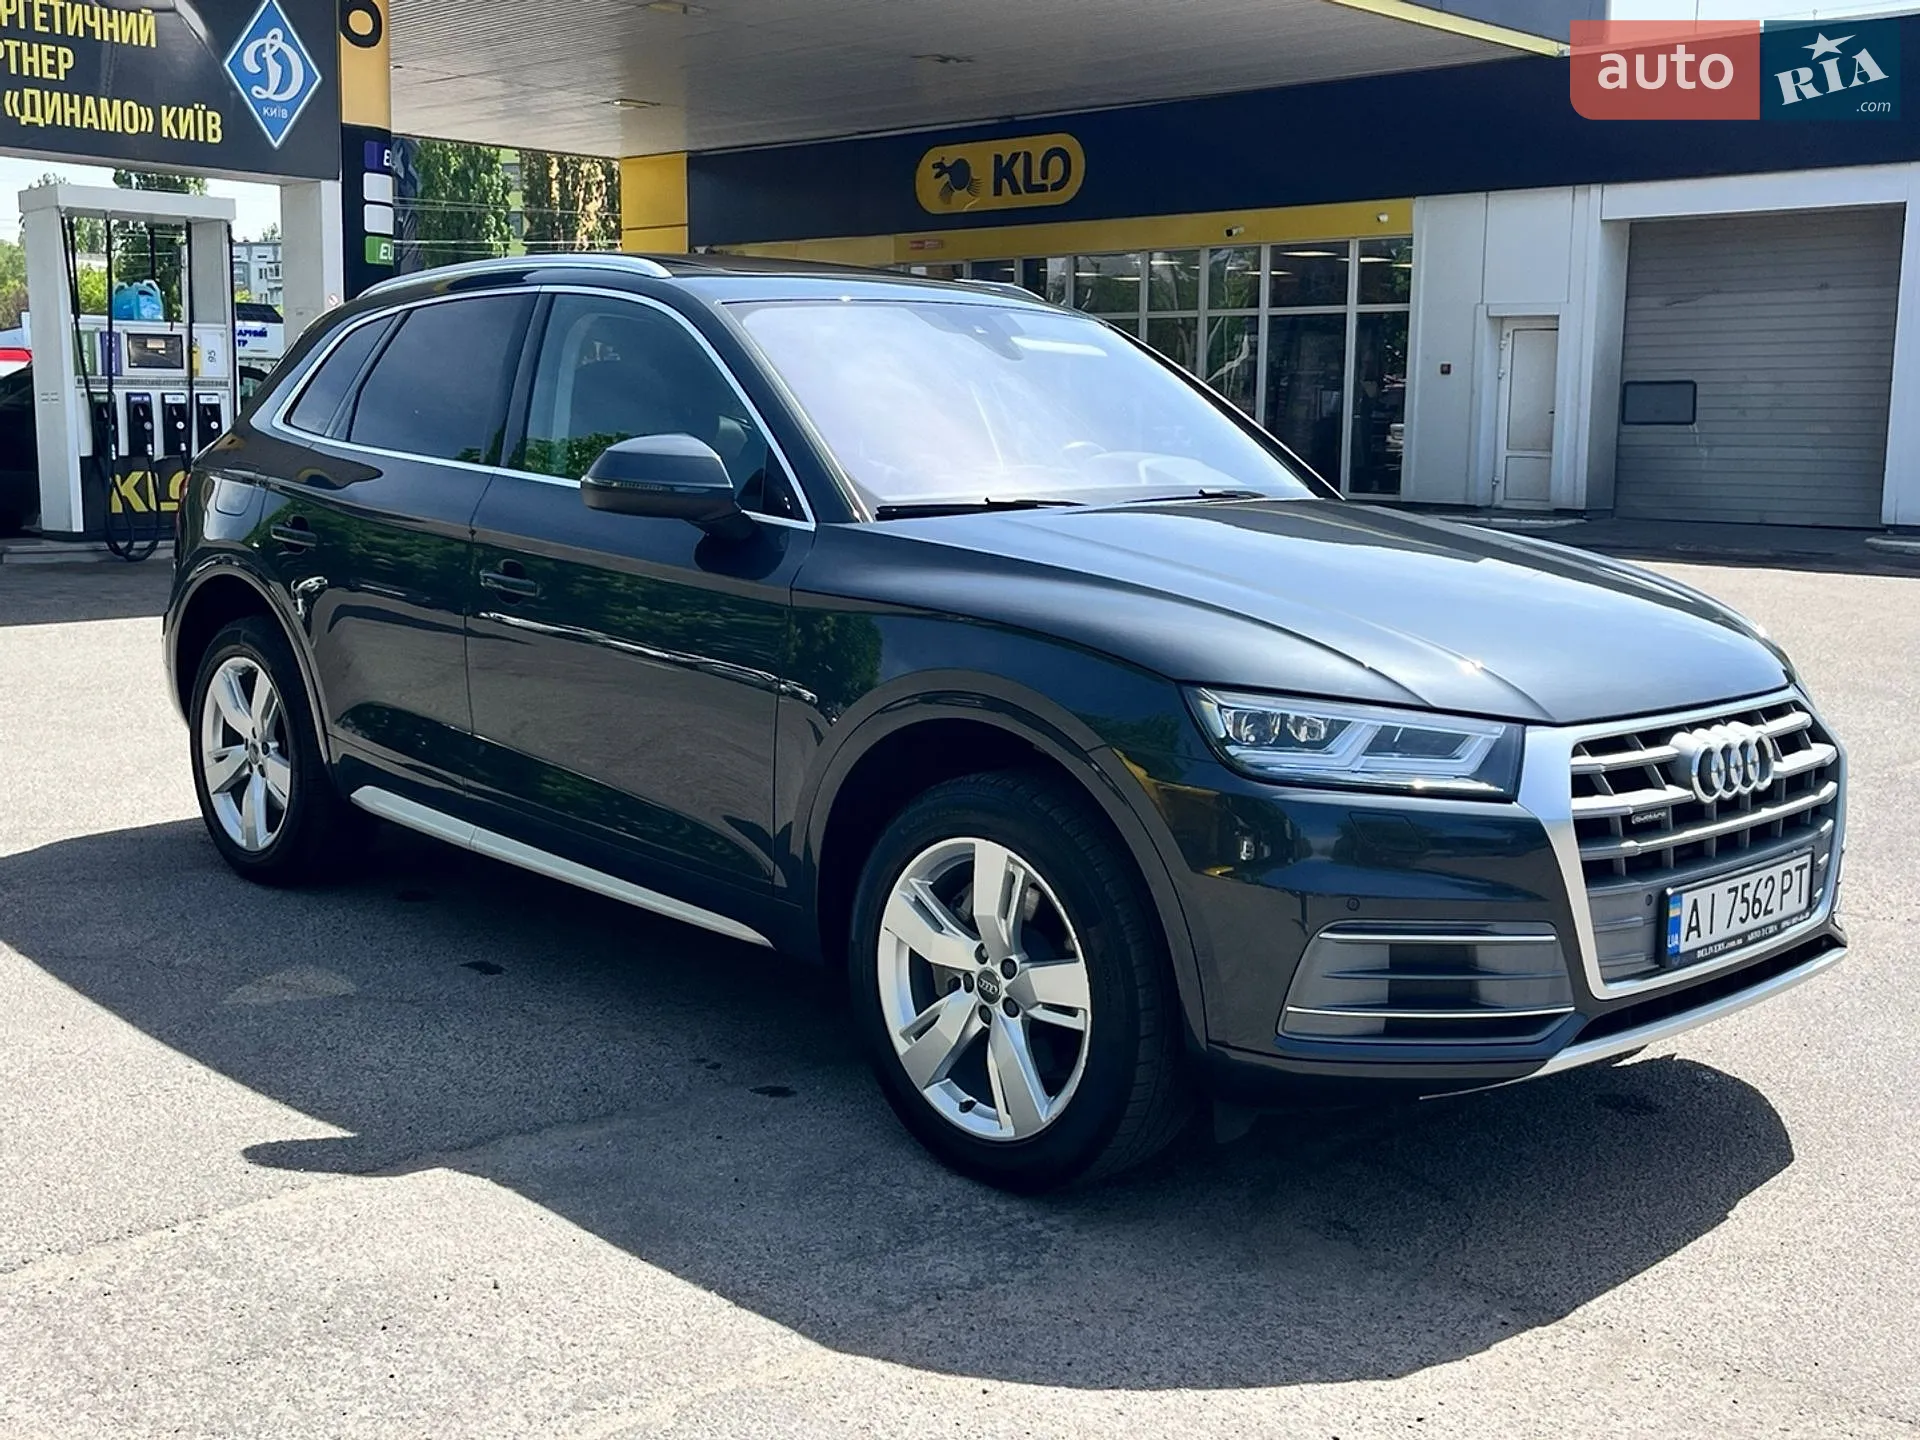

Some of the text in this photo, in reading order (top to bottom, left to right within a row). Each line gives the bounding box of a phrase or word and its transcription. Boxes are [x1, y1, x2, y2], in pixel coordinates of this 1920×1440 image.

[4, 88, 223, 144] «ДИНАМО» КИЇВ
[262, 105, 288, 119] КИЇВ
[993, 147, 1072, 196] KLO
[1726, 875, 1775, 930] 7562
[1779, 863, 1809, 911] PT
